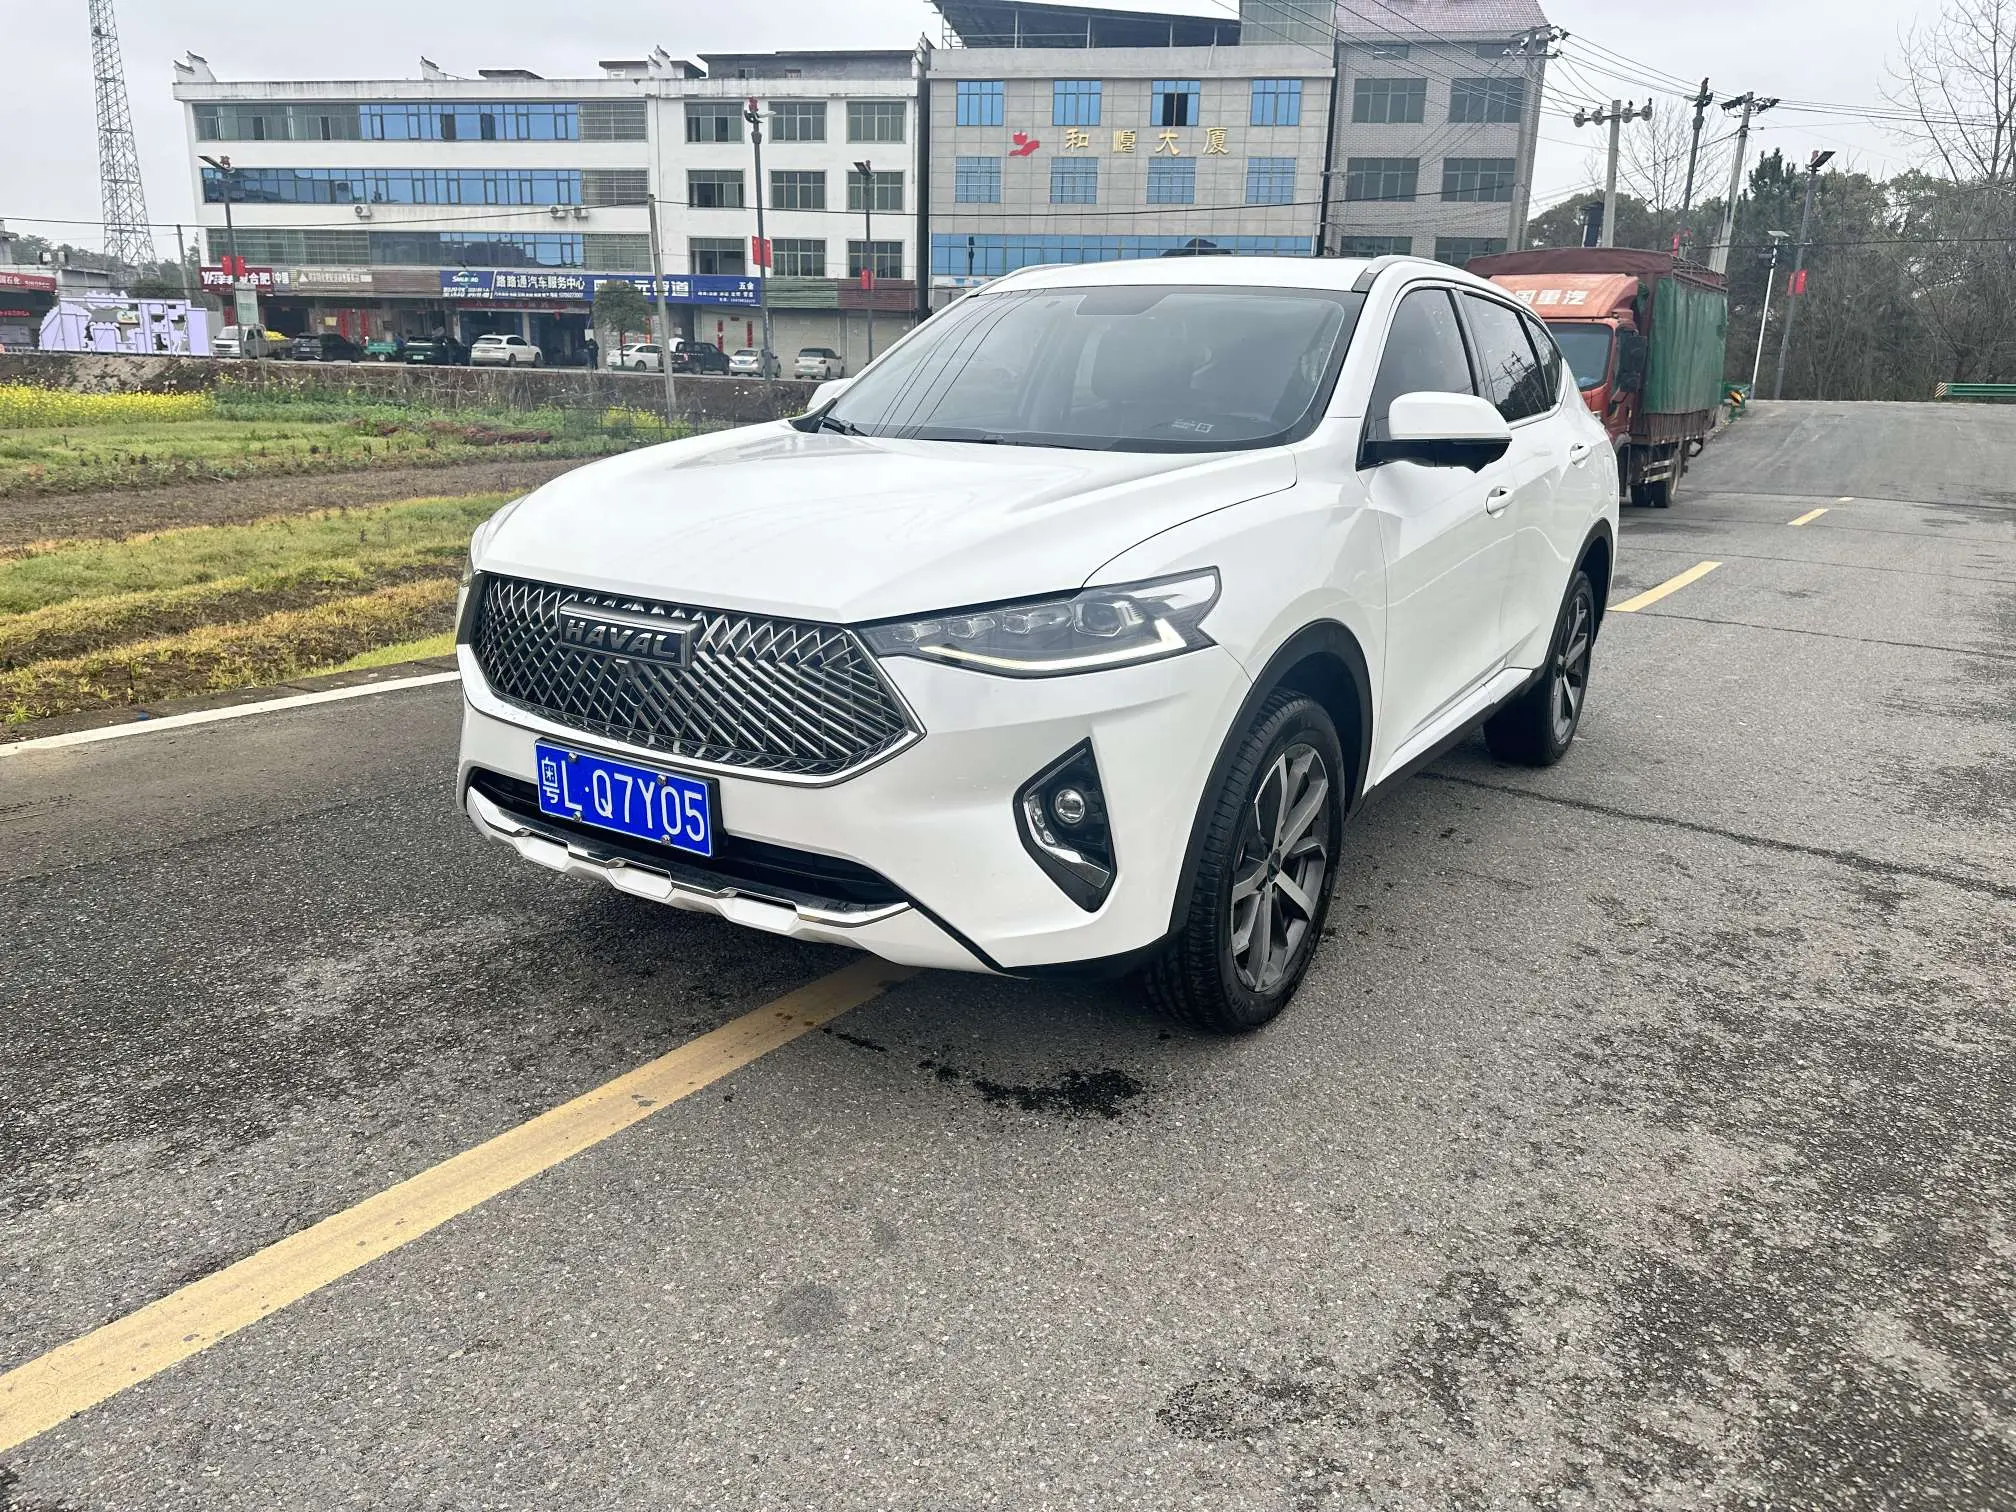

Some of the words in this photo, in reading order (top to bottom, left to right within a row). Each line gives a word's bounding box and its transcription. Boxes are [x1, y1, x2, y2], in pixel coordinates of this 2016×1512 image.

[496, 274, 586, 290] 路路通汽车服务中心
[593, 279, 689, 297] 元管道
[565, 618, 676, 659] HAVAL
